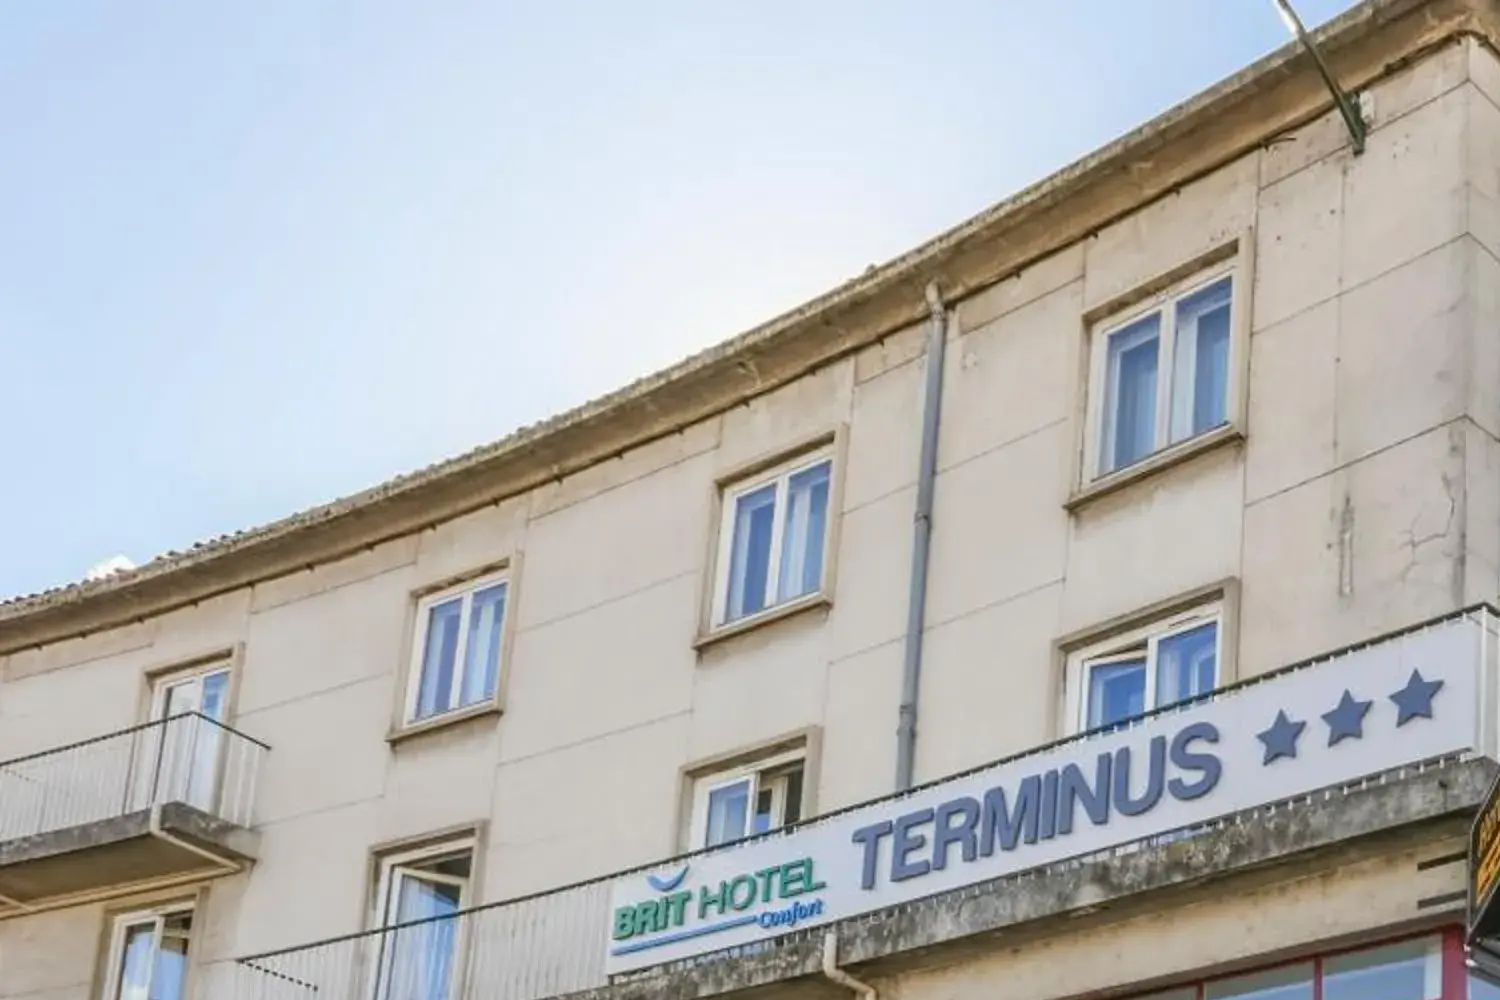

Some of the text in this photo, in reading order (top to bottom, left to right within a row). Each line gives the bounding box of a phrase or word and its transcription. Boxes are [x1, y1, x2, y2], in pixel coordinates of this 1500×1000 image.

[851, 721, 1223, 891] TERMINUS
[612, 856, 828, 941] BRIT HOTEL
[756, 898, 826, 929] Confort
